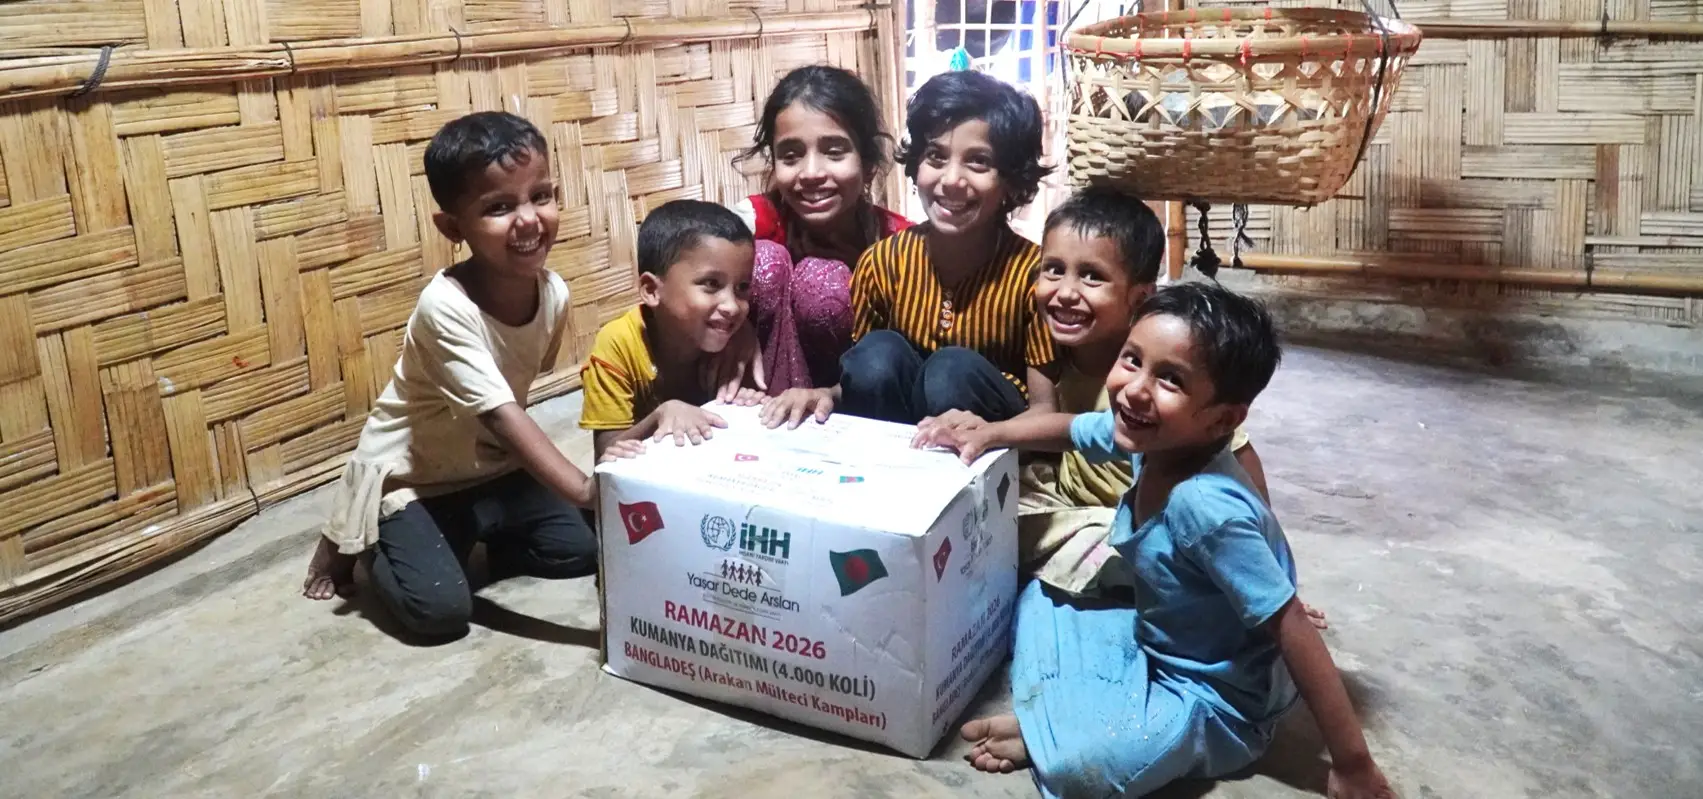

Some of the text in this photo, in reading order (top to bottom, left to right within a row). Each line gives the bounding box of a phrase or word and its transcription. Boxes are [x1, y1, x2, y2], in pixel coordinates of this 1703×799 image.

[687, 572, 719, 592] Yaşar
[722, 582, 757, 602] Dede
[761, 592, 800, 613] Arslan
[630, 616, 876, 701] KUMANYA DAĞITIMI (4.000 KOLİ)
[664, 600, 767, 646] RAMAZAN
[772, 631, 826, 659] 2026
[624, 641, 887, 730] BANGLADEŞ (Arakan Mülteci Kampları)
